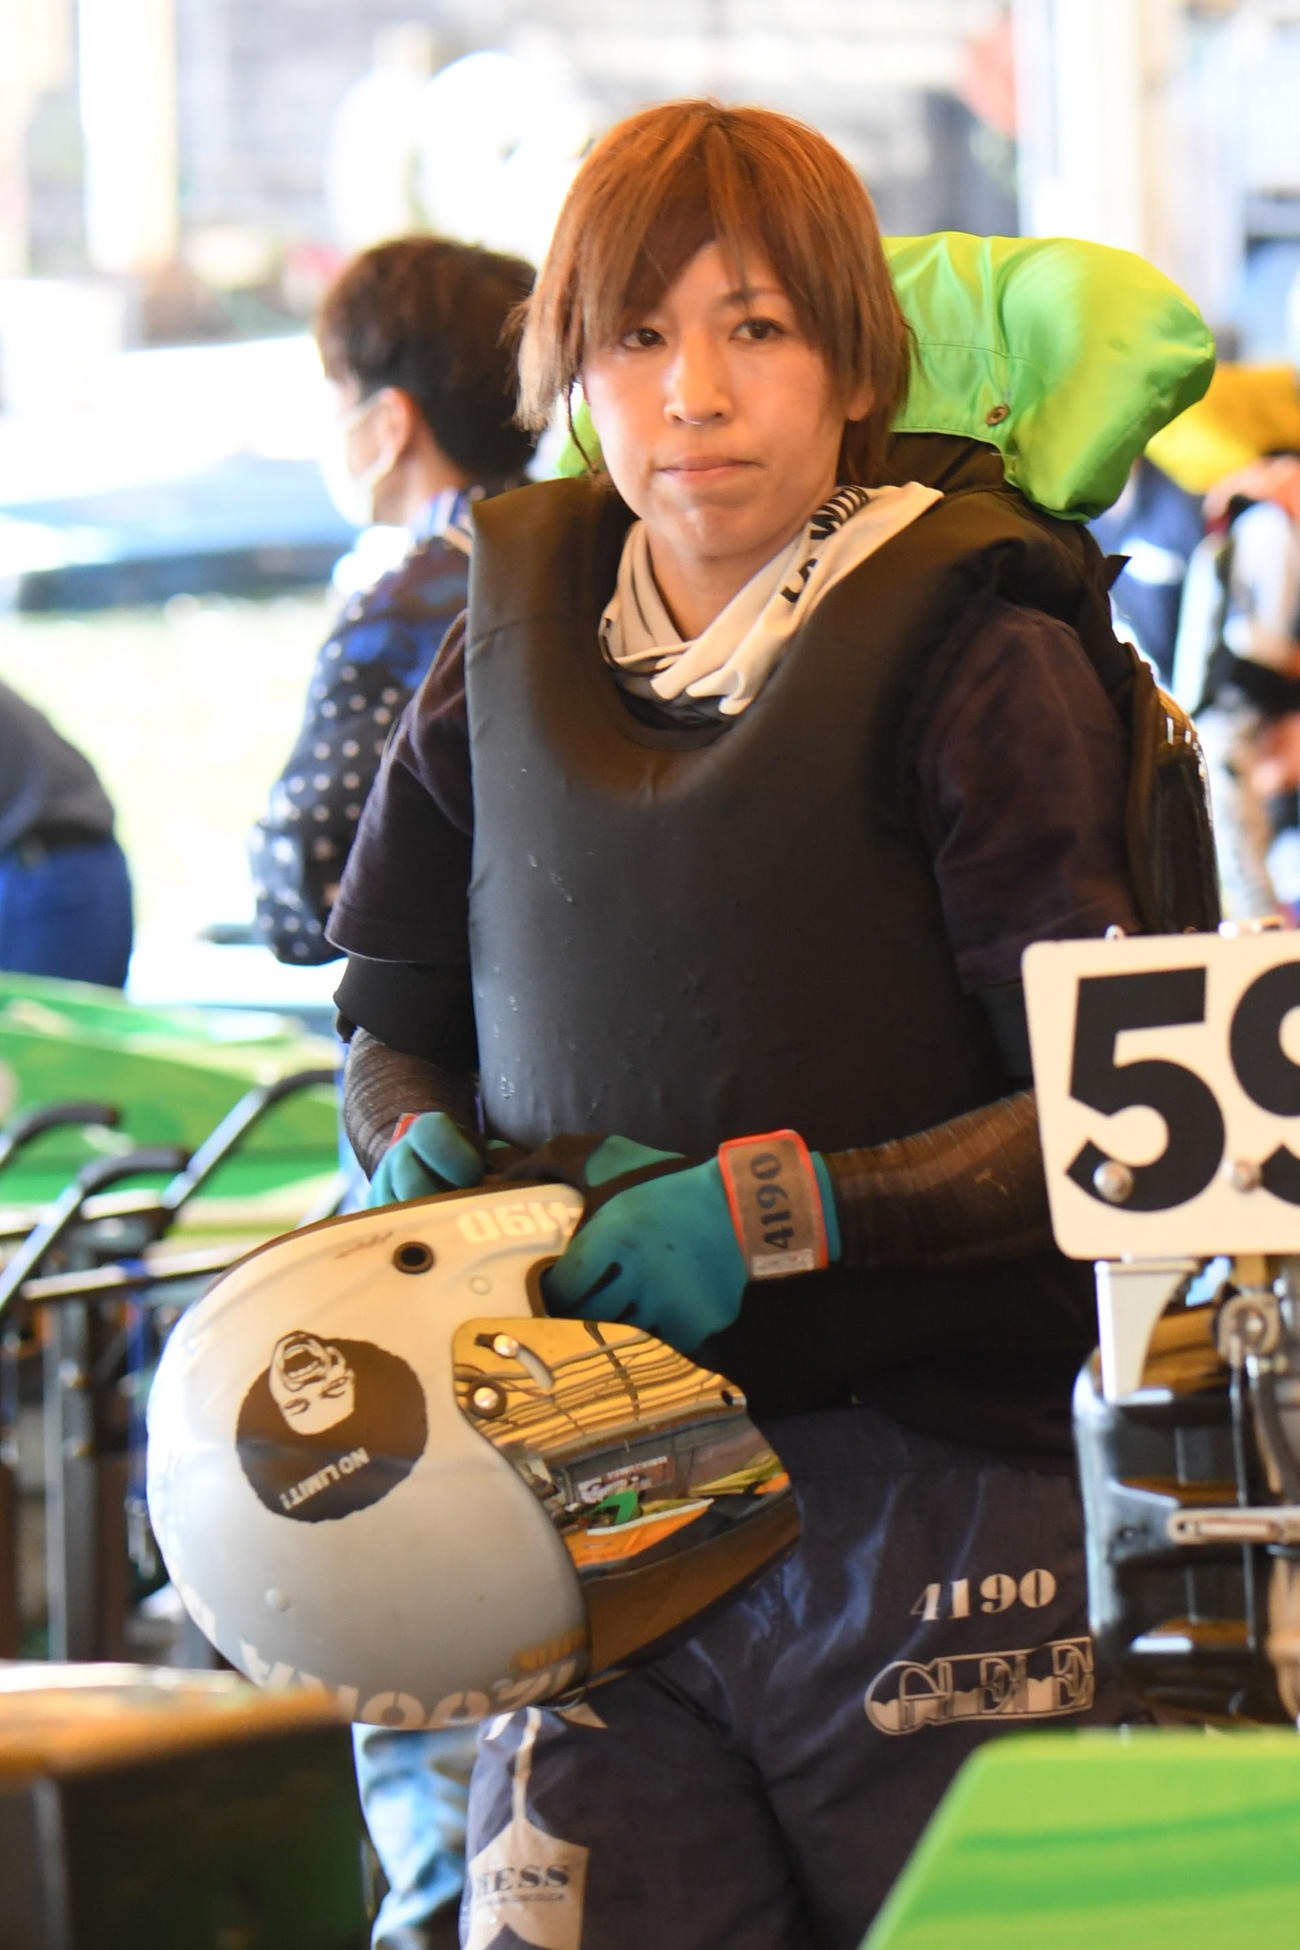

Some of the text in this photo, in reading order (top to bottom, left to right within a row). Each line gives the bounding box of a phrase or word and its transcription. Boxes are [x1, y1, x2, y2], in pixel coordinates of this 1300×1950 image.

[749, 1152, 796, 1250] 4190
[337, 1447, 370, 1474] NO
[909, 1568, 1057, 1622] 4190
